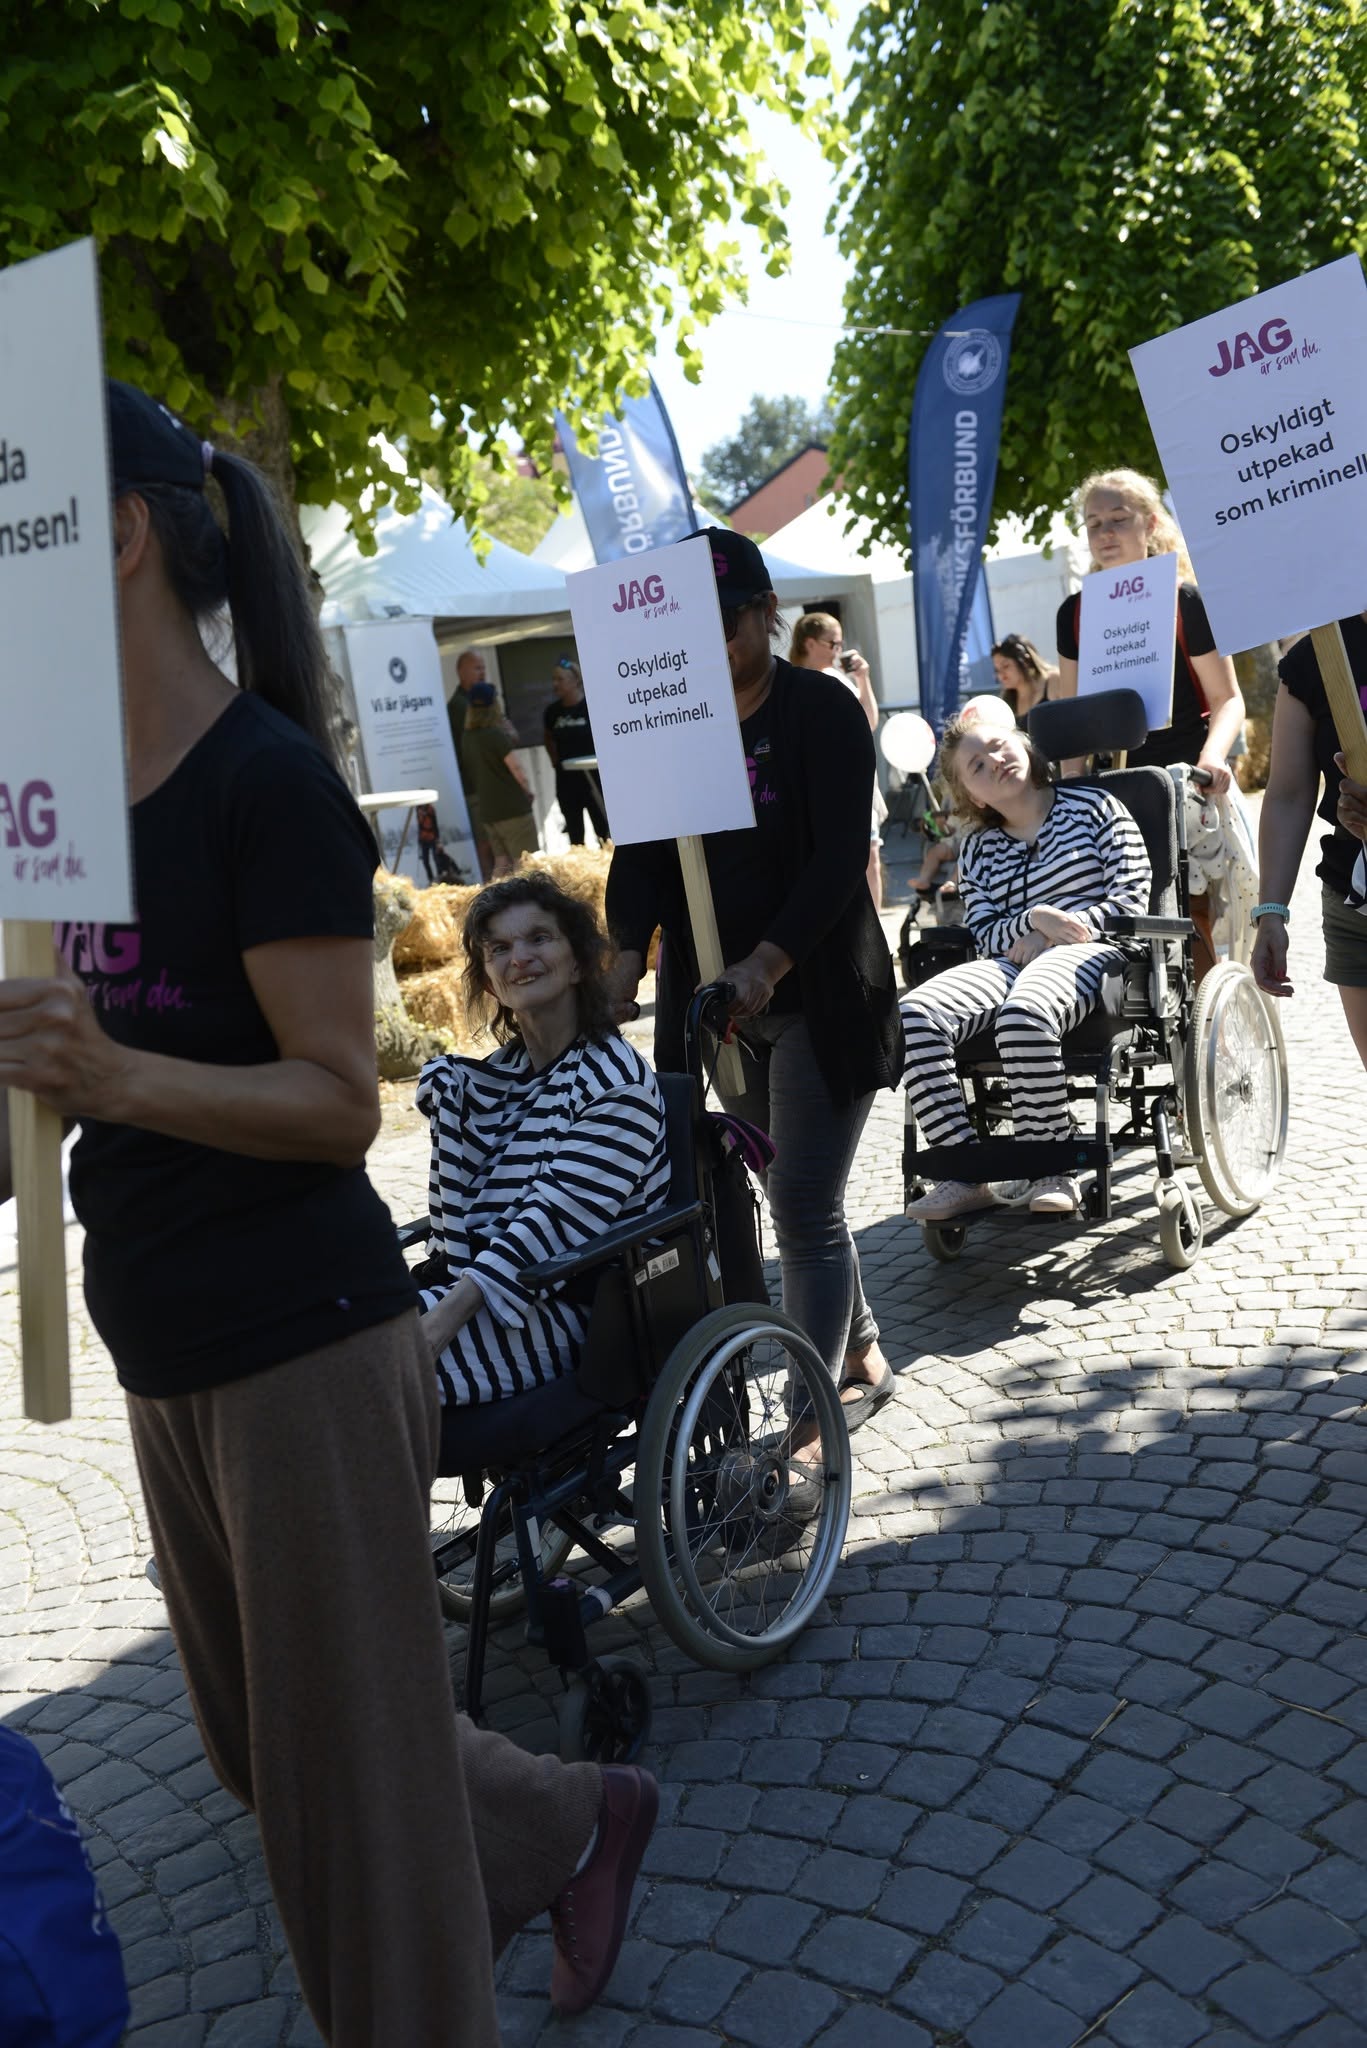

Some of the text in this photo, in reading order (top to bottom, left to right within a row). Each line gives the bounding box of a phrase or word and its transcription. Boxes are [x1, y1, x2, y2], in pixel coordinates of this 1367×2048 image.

[1208, 318, 1293, 377] JAG
[1260, 361, 1272, 375] är
[1276, 348, 1300, 370] som
[1220, 398, 1335, 454] Oskyldigt
[1238, 431, 1334, 483] utpekad
[1215, 497, 1264, 526] som
[612, 574, 665, 613] JAG
[1109, 575, 1144, 600] JAG
[1103, 620, 1151, 640] Oskyldigt
[1106, 637, 1146, 656] utpekad
[617, 649, 689, 678] Oskyldigt
[1091, 651, 1160, 676] som kriminell.
[627, 677, 687, 706] utpekad
[612, 719, 643, 736] som
[644, 701, 714, 730] kriminell.
